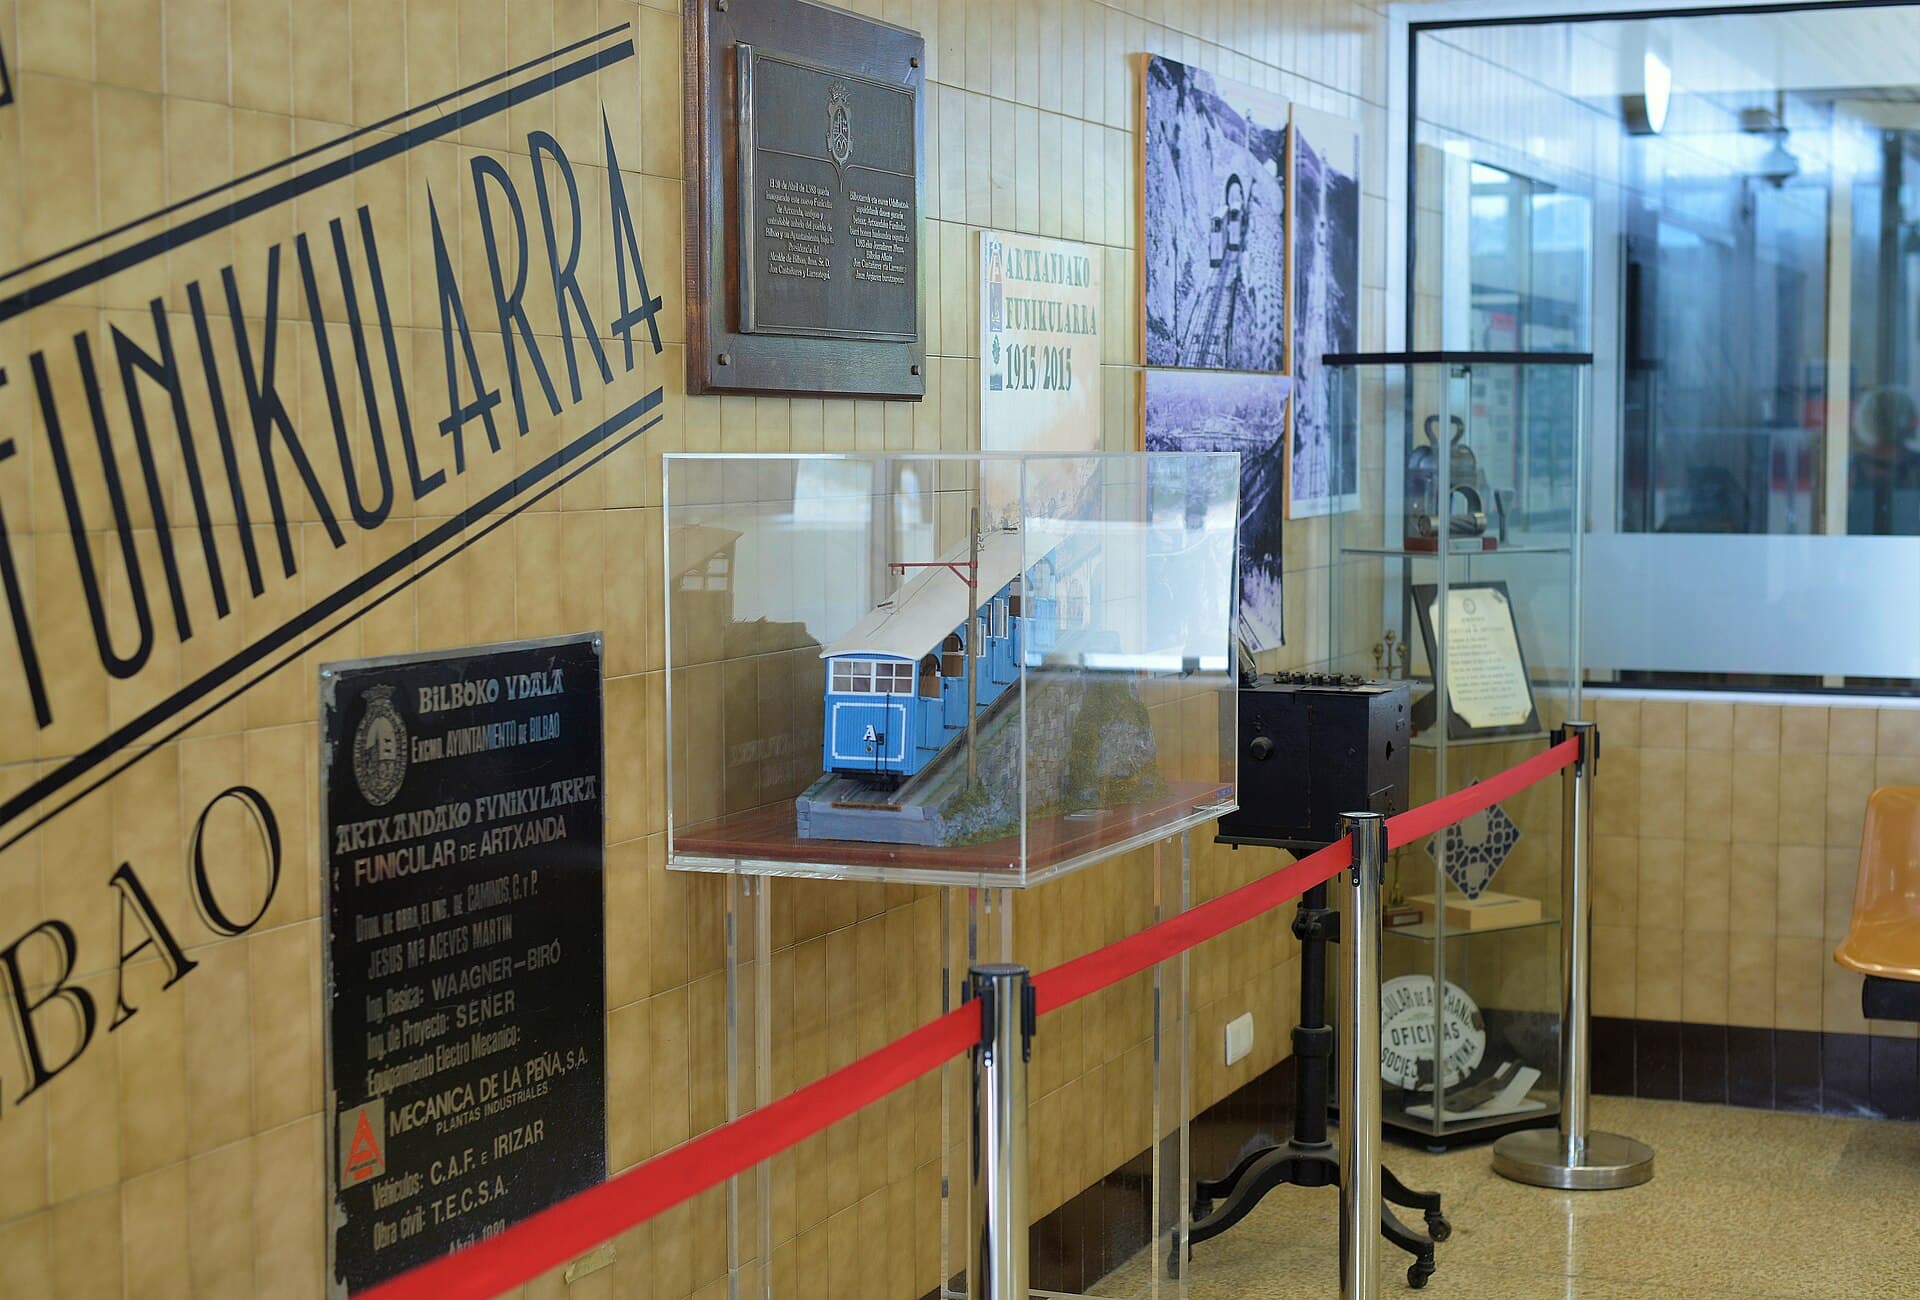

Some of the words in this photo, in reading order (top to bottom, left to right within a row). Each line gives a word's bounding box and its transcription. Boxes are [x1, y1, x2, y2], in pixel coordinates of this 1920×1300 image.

[1005, 247, 1090, 288] ARTXANDAKO
[1005, 296, 1097, 336] FUNIKULARRA
[446, 720, 516, 758] AYUNTAMIENTO
[529, 712, 560, 742] BILBAO
[863, 724, 877, 742] A
[335, 803, 471, 855] ARTXANDAKO
[354, 839, 456, 887] FUNICULAR
[459, 842, 476, 862] DE
[479, 814, 567, 858] ARTXANDA
[0, 785, 282, 1106] BAO
[368, 943, 403, 980] JESUS
[428, 926, 469, 962] ACEVES
[472, 914, 513, 950] MARTIN
[387, 1023, 401, 1053] de
[402, 1011, 450, 1047] Proyecto:
[1391, 1022, 1460, 1047] OFICIAS
[436, 1038, 470, 1073] Electro
[389, 1083, 475, 1138] MECANICA
[479, 1073, 499, 1104] DE
[503, 1066, 522, 1095] LA
[566, 1047, 589, 1071] S.A.
[436, 1107, 481, 1136] PLANTAS
[430, 1150, 476, 1186] C.A.F.
[493, 1119, 544, 1160] IRIZAR
[373, 1220, 397, 1251] Obra
[400, 1205, 426, 1240] civil:
[431, 1175, 510, 1225] T.E.C.S.A.
